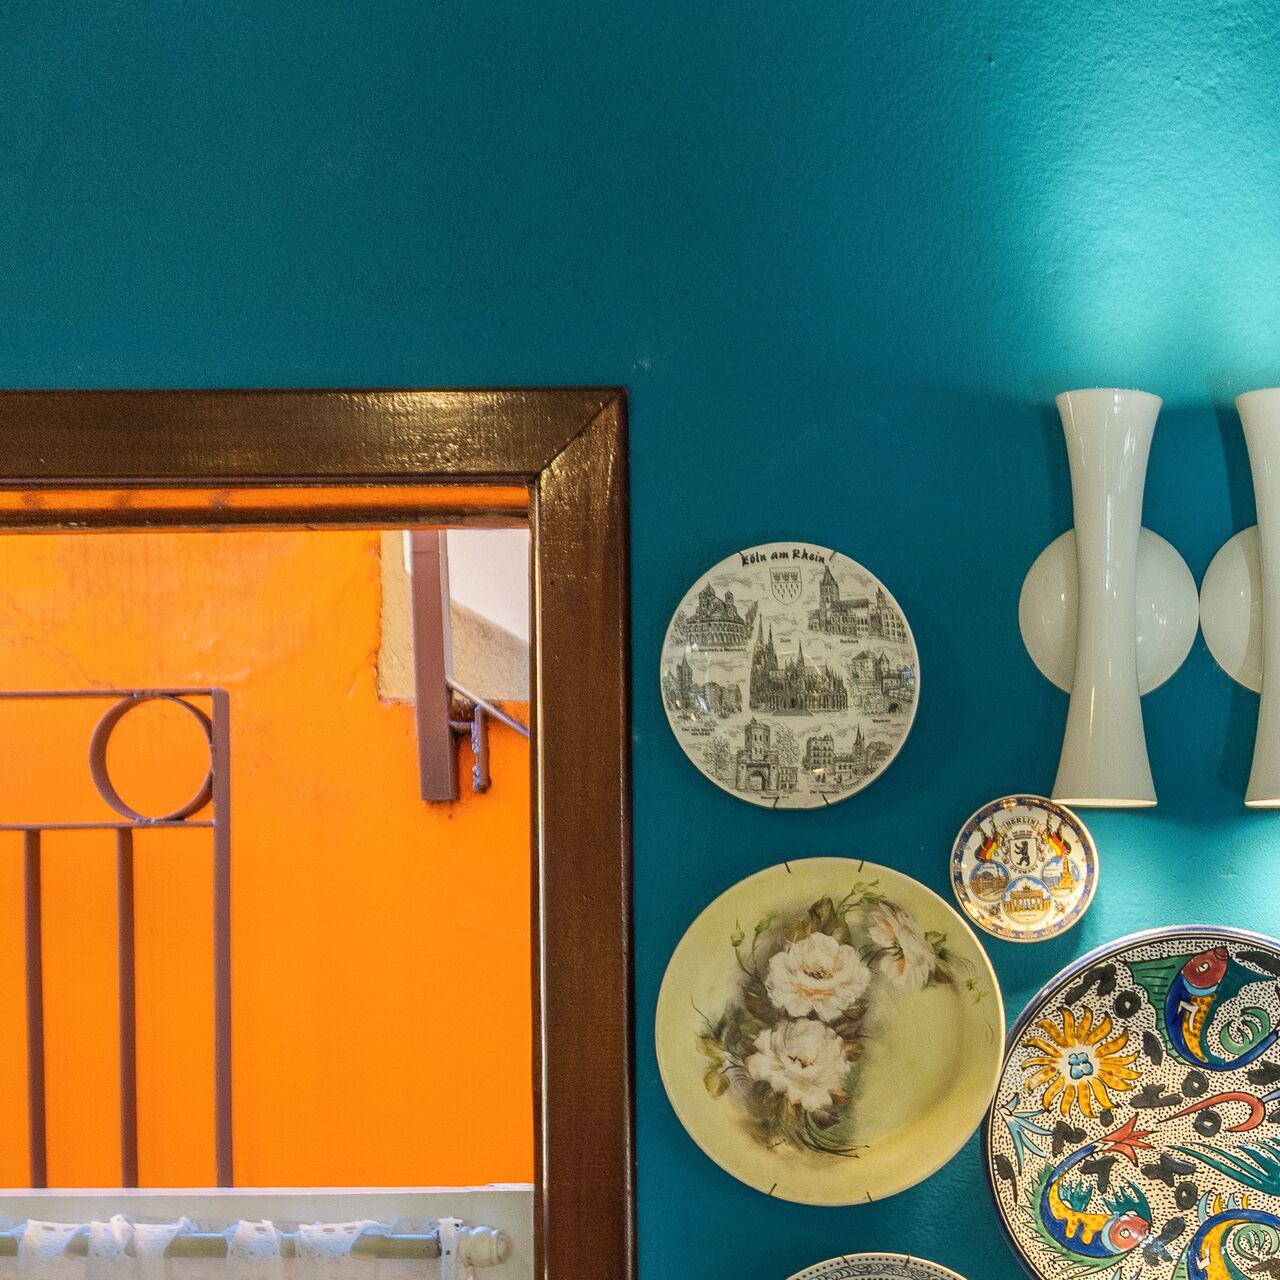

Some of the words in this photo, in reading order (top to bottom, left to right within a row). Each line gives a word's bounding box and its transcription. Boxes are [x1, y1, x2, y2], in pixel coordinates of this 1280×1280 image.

[741, 551, 767, 567] Köln
[771, 551, 789, 560] am
[792, 548, 825, 564] Rhein
[1005, 817, 1037, 827] BERLIN
[1010, 864, 1039, 875] GERMANY
